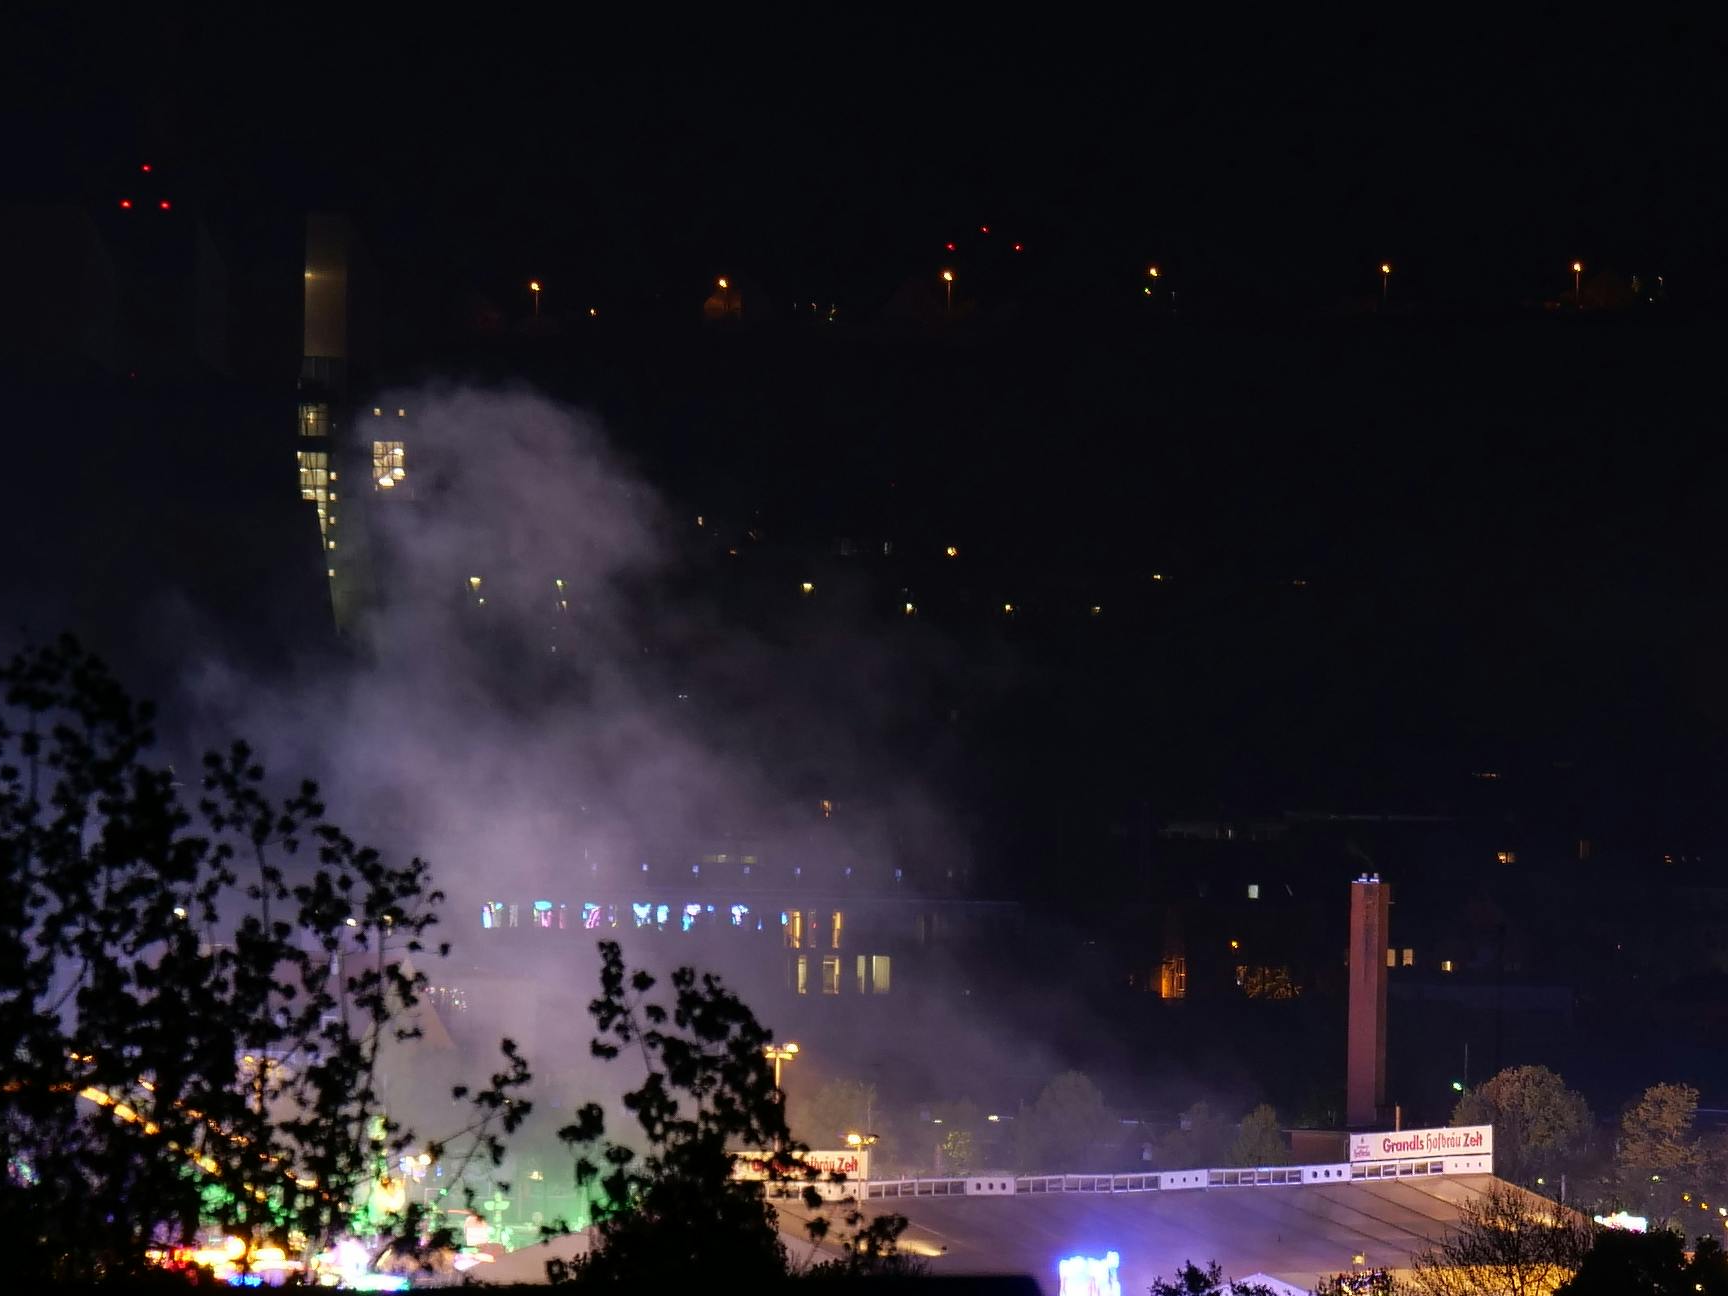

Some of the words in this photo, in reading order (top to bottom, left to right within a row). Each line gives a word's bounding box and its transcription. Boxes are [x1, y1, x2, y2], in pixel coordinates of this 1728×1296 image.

[1383, 1135, 1424, 1153] Grandls
[1463, 1131, 1483, 1148] Zelt
[837, 1156, 858, 1173] Zelt
